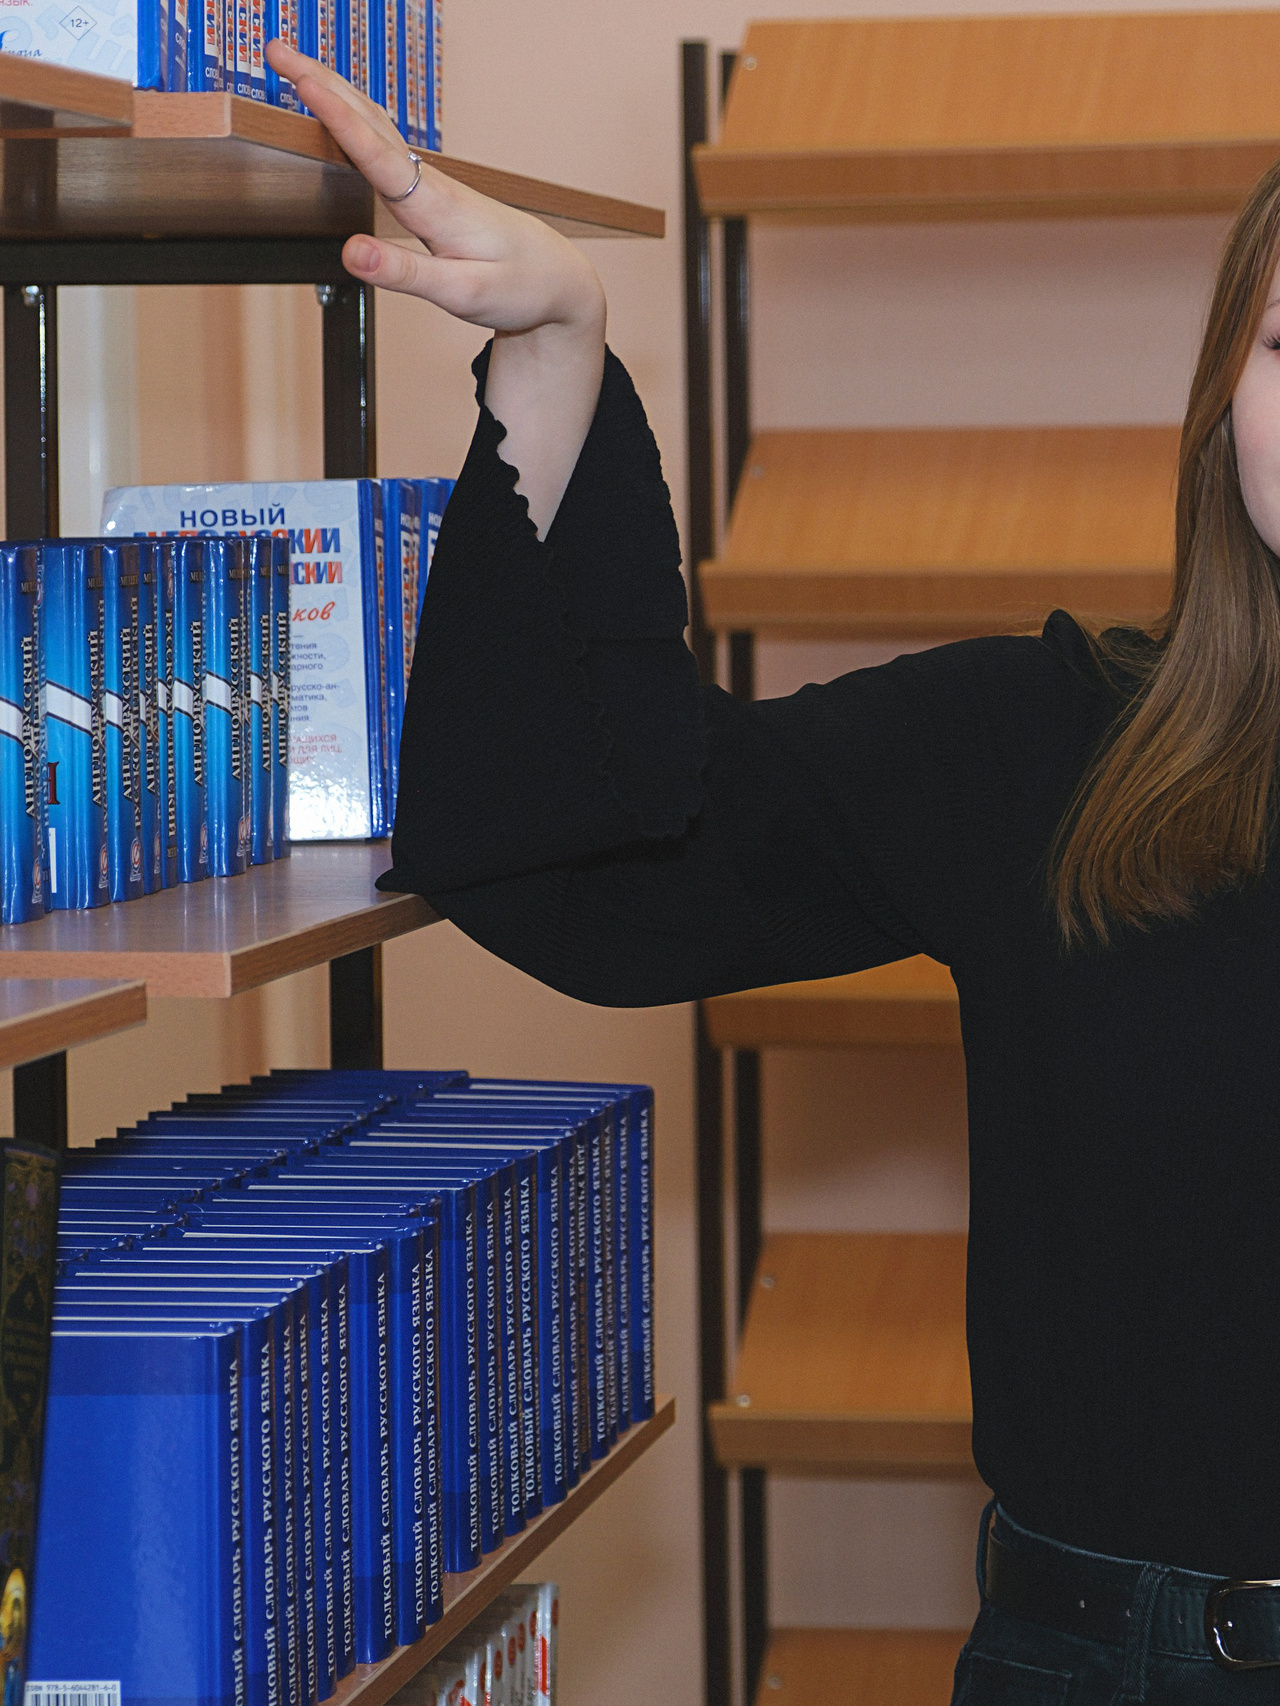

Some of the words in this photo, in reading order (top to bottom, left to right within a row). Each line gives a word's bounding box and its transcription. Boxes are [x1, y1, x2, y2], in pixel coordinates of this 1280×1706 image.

[70, 19, 89, 28] 12+
[180, 503, 286, 528] НОВЫЙ
[550, 1166, 558, 1222] ЯЗЫКА
[592, 1136, 600, 1190] ЯЗЫКА
[504, 1187, 512, 1245] ЯЗЫКА
[520, 1177, 530, 1234] ЯЗЫКА
[593, 1195, 602, 1273] РУССКОГО
[378, 1272, 386, 1337] ЯЗЫКА
[412, 1263, 420, 1327] ЯЗЫКА
[426, 1247, 434, 1311] ЯЗЫКА
[487, 1265, 495, 1350] РУССКОГО
[505, 1251, 515, 1335] РУССКОГО
[521, 1239, 532, 1322] РУССКОГО
[551, 1228, 559, 1309] РУССКОГО
[300, 1313, 308, 1382] ЯЗЫКА
[321, 1298, 329, 1365] ЯЗЫКА
[466, 1278, 476, 1365] РУССКОГО
[551, 1314, 560, 1387] СЛОВАРЬ
[595, 1279, 604, 1348] СЛОВАРЬ
[229, 1359, 238, 1431] ЯЗЫКА
[261, 1342, 270, 1413] ЯЗЫКА
[340, 1356, 348, 1451] РУССКОГО
[379, 1344, 388, 1438] РУССКОГО
[412, 1333, 422, 1426] РУССКОГО
[426, 1318, 435, 1409] РУССКОГО
[488, 1356, 497, 1432] СЛОВАРЬ
[507, 1340, 517, 1415] СЛОВАРЬ
[523, 1328, 533, 1401] СЛОВАРЬ
[595, 1354, 606, 1442] ТОЛКОВЫЙ
[284, 1401, 293, 1500] РУССКОГО
[301, 1388, 310, 1486] РУССКОГО
[321, 1372, 330, 1469] РУССКОГО
[468, 1370, 477, 1447] СЛОВАРЬ
[551, 1393, 563, 1484] ТОЛКОВЫЙ
[230, 1438, 241, 1542] РУССКОГО
[261, 1420, 273, 1522] РУССКОГО
[381, 1443, 390, 1527] СЛОВАРЬ
[413, 1431, 423, 1514] СЛОВАРЬ
[428, 1415, 438, 1495] СЛОВАРЬ
[488, 1437, 499, 1533] ТОЛКОВЫЙ
[508, 1421, 520, 1515] ТОЛКОВЫЙ
[522, 1407, 536, 1500] ТОЛКОВЫЙ
[304, 1493, 312, 1581] СЛОВАРЬ
[323, 1474, 332, 1561] СЛОВАРЬ
[341, 1458, 350, 1542] СЛОВАРЬ
[468, 1453, 478, 1551] ТОЛКОВЫЙ
[264, 1528, 274, 1620] СЛОВАРЬ
[285, 1508, 294, 1597] СЛОВАРЬ
[381, 1533, 392, 1638] ТОЛКОВЫЙ
[413, 1520, 424, 1623] ТОЛКОВЫЙ
[428, 1502, 439, 1604] ТОЛКОВЫЙ
[233, 1549, 242, 1641] СЛОВАРЬ
[324, 1568, 335, 1676] ТОЛКОВЫЙ
[341, 1550, 352, 1656] ТОЛКОВЫЙ
[232, 1648, 243, 1706] ОВЫЙ
[264, 1627, 278, 1706] КОВЫЙ
[286, 1604, 297, 1704] ОЛКОВЫЙ
[304, 1587, 315, 1697] ТОЛКОВЫЙ
